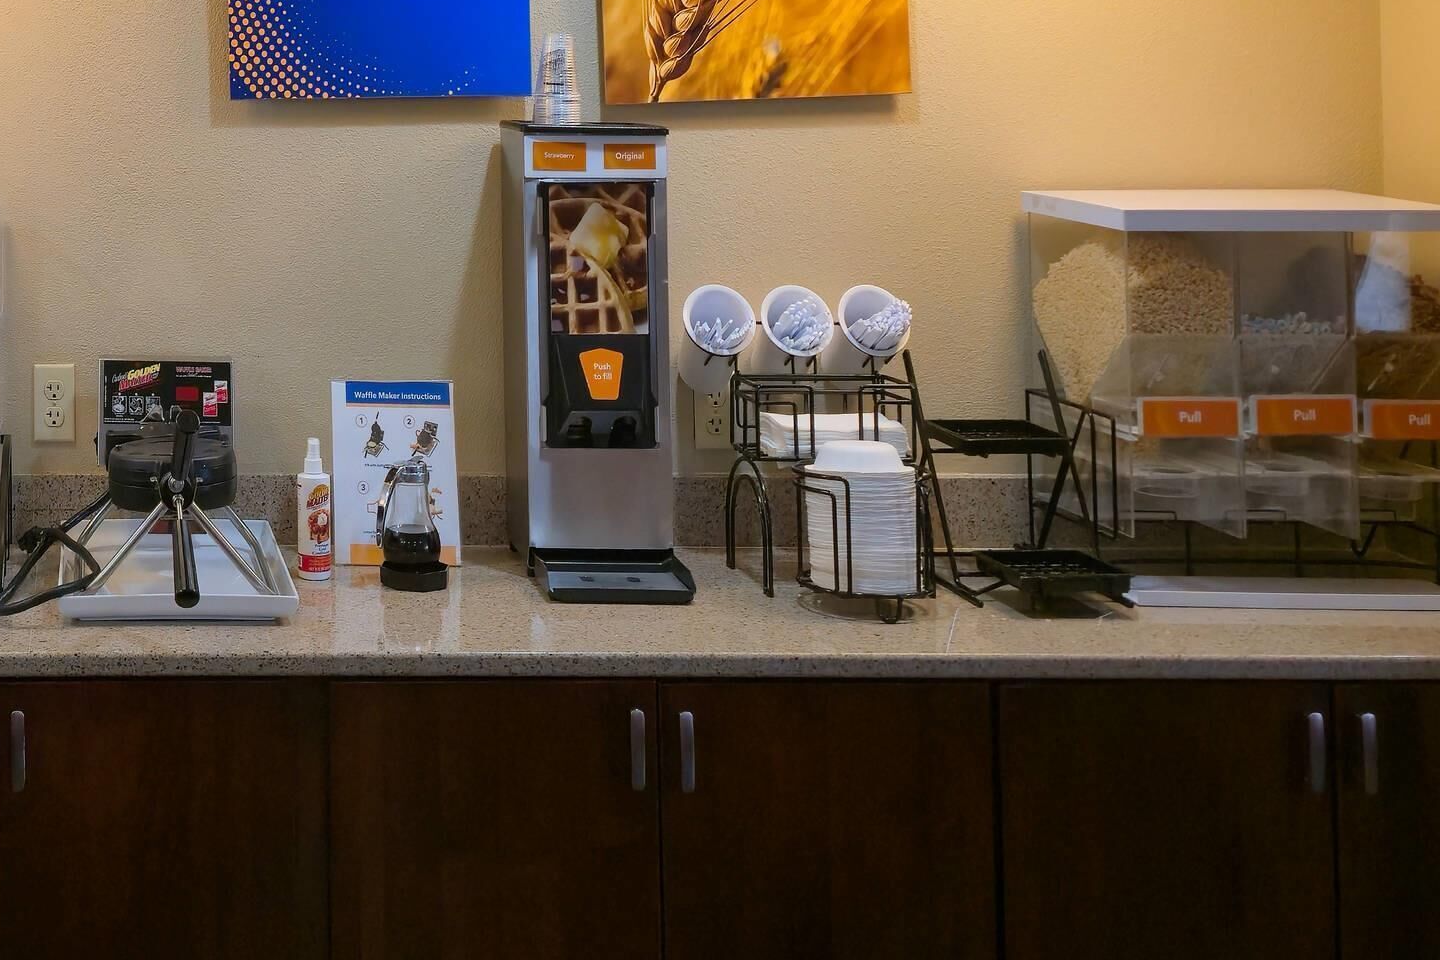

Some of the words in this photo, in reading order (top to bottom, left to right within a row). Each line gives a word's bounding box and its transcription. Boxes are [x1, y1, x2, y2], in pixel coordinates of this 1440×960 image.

[544, 151, 576, 160] Strawberry
[615, 151, 645, 161] Original
[594, 362, 611, 370] Push
[127, 362, 160, 381] GOLDEN
[603, 372, 613, 380] fill
[354, 391, 377, 399] Waffle
[378, 391, 400, 399] Maker
[401, 392, 442, 400] Instructions
[1179, 410, 1202, 423] Pull
[1293, 409, 1316, 421] Pull
[1409, 413, 1431, 426] Pull
[361, 483, 366, 491] 3
